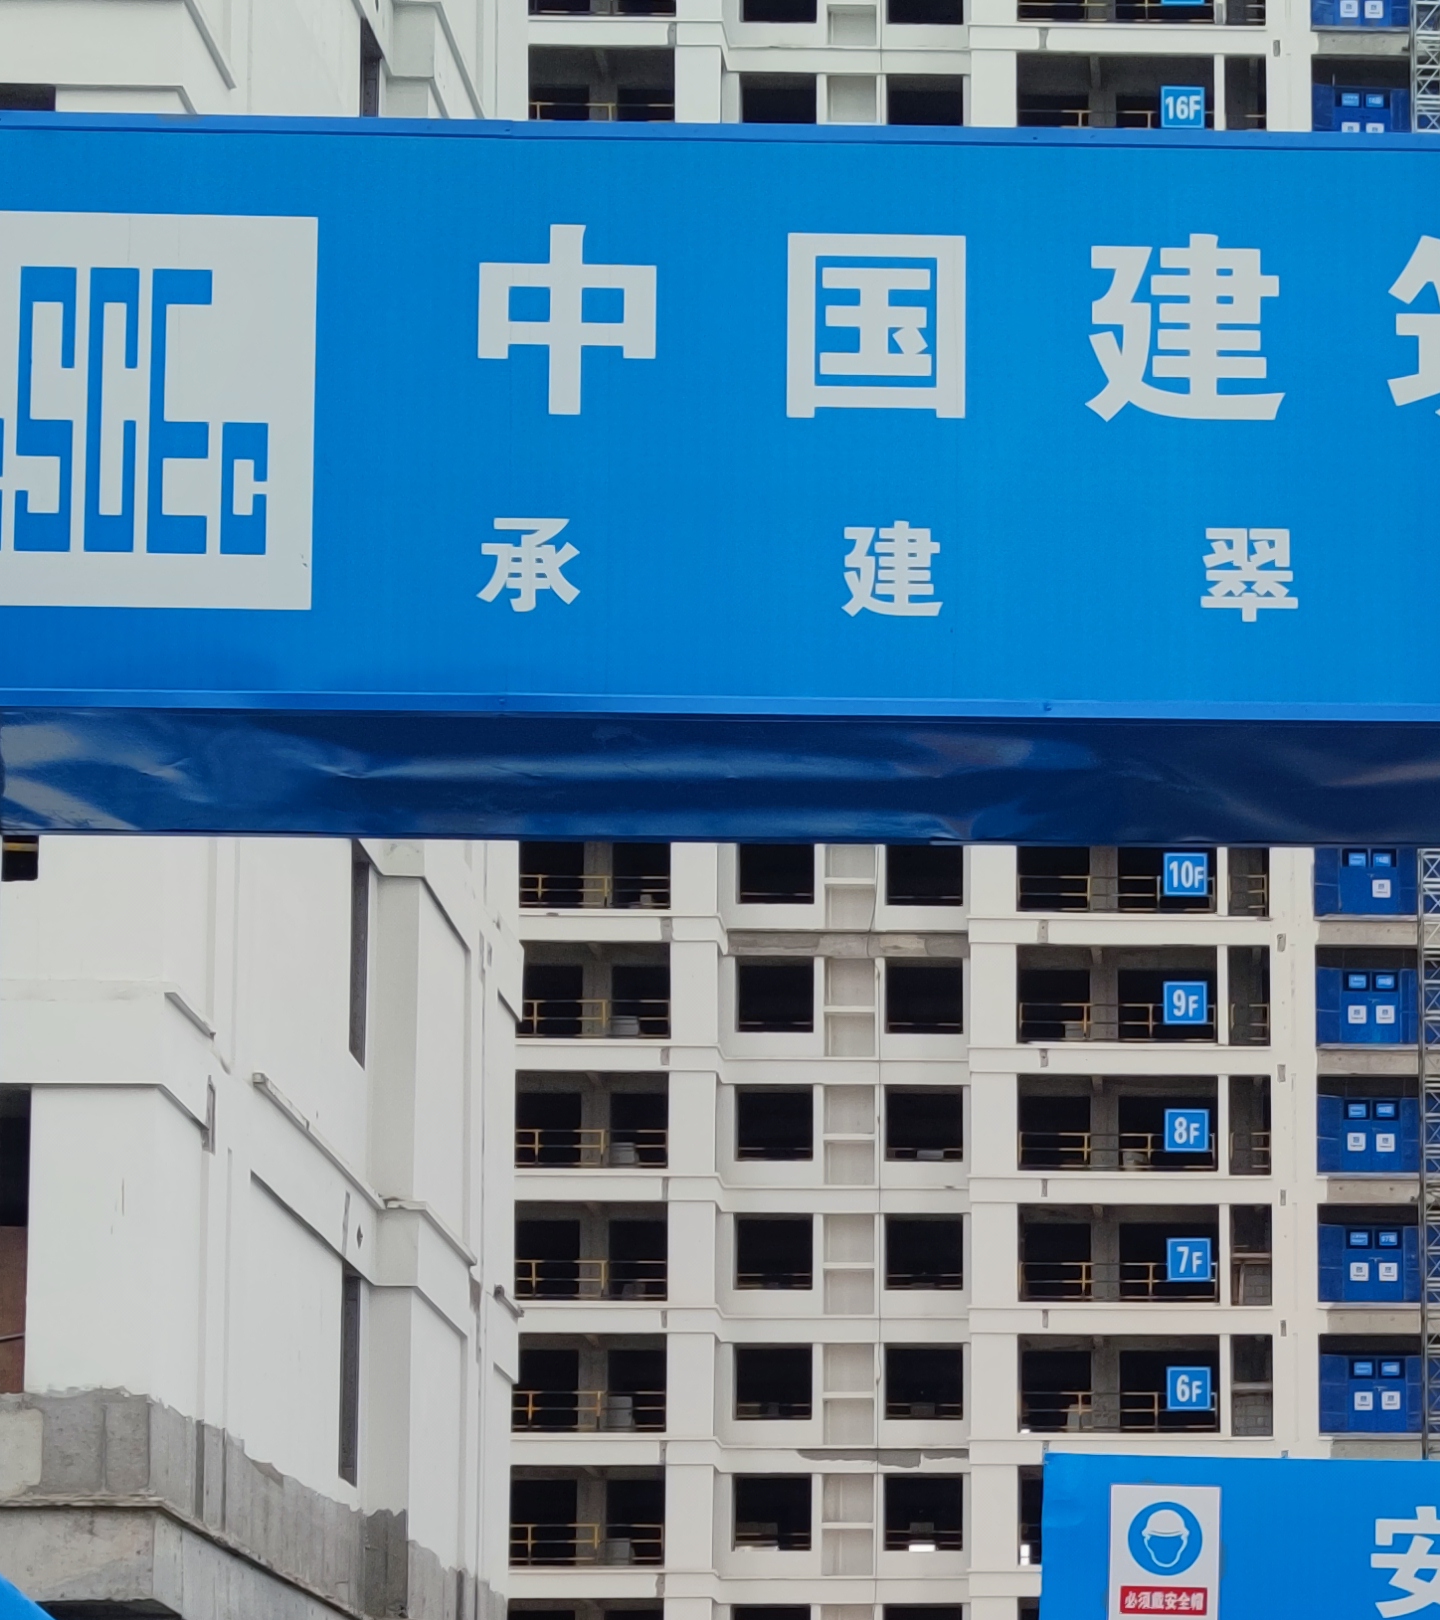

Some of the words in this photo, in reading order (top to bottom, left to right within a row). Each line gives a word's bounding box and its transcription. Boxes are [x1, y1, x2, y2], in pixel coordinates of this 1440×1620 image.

[1165, 95, 1202, 120] 16F
[1168, 861, 1204, 889] 10F
[1172, 988, 1199, 1017] 9F
[1173, 1116, 1200, 1145] 8F
[1176, 1245, 1203, 1273] 7F
[1175, 1374, 1202, 1403] 6F
[1124, 1591, 1205, 1611] 必须戴安全帽
